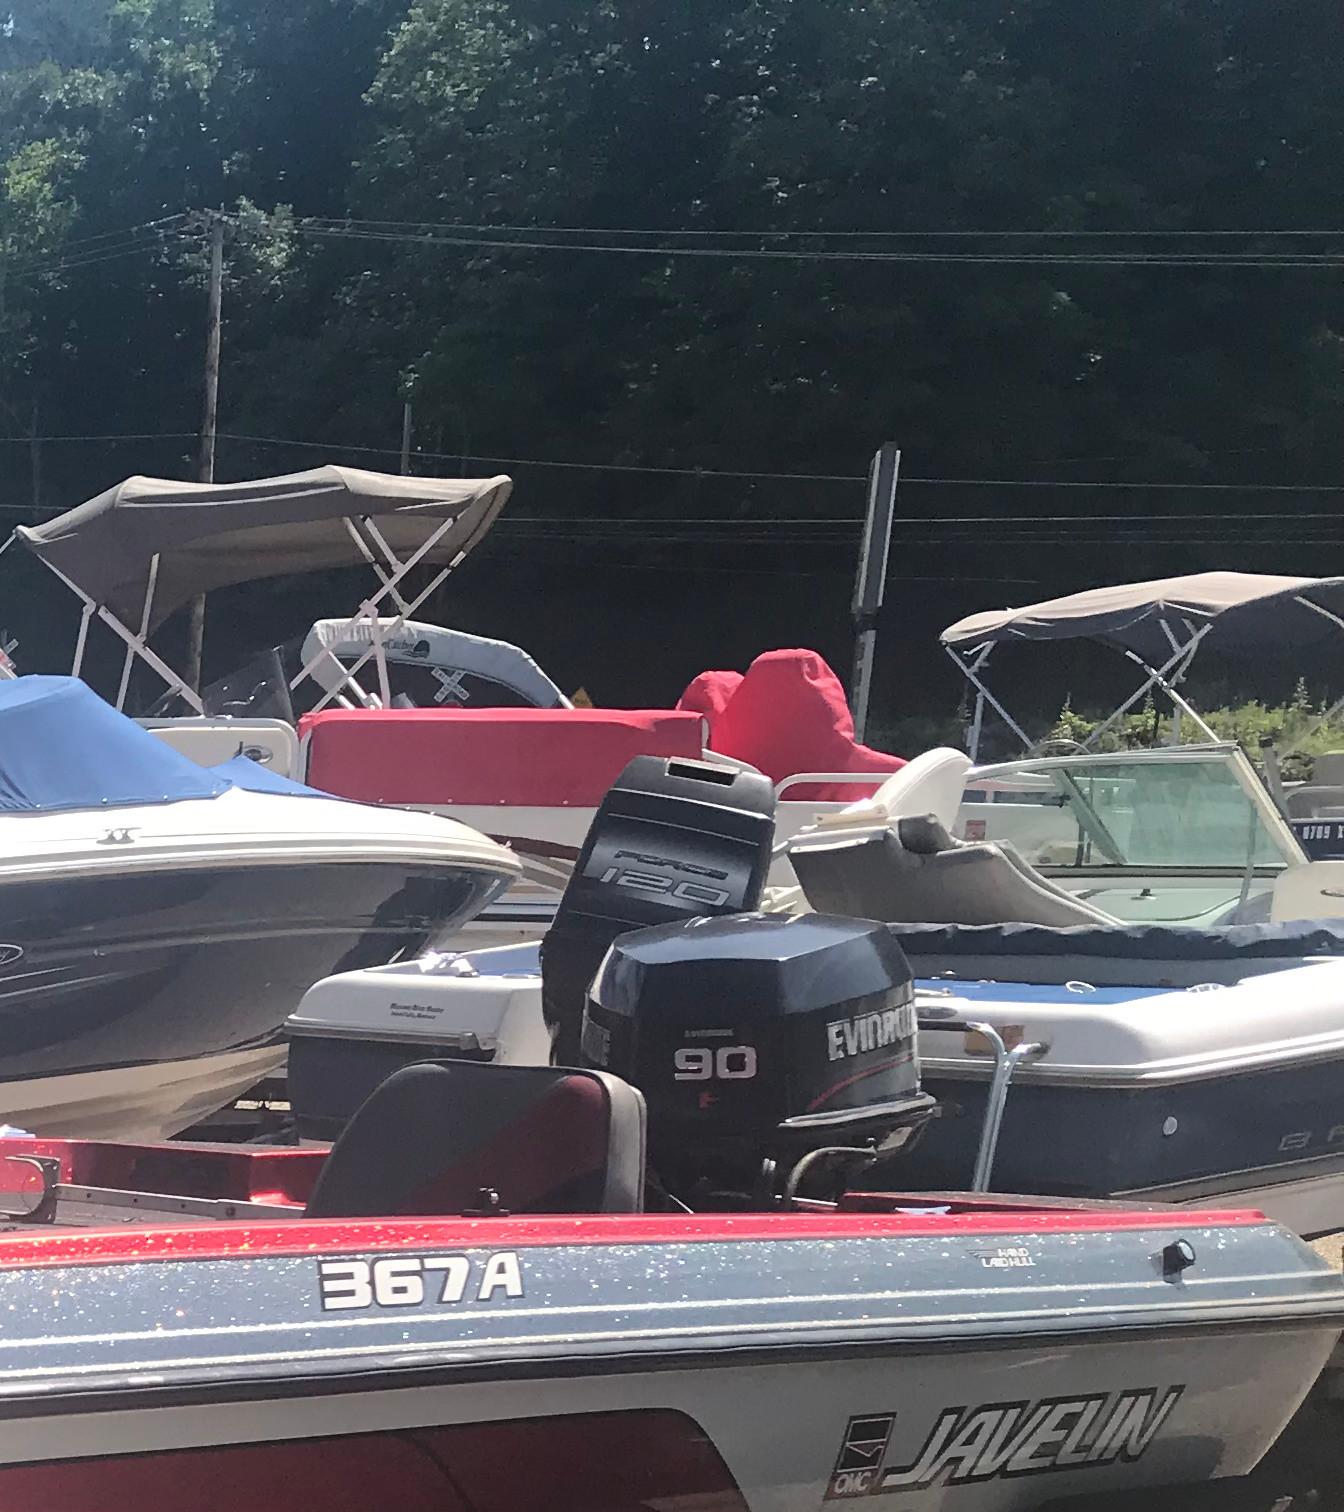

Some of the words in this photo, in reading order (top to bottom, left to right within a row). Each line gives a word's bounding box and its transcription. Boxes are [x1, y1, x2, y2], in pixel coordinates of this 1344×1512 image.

[614, 849, 729, 881] FORCE
[599, 866, 731, 907] 120
[674, 1046, 757, 1081] 90
[998, 1247, 1029, 1257] HAND
[318, 1250, 525, 1312] 367A
[881, 1385, 1186, 1490] JAVELIN
[833, 1472, 871, 1495] OMC
